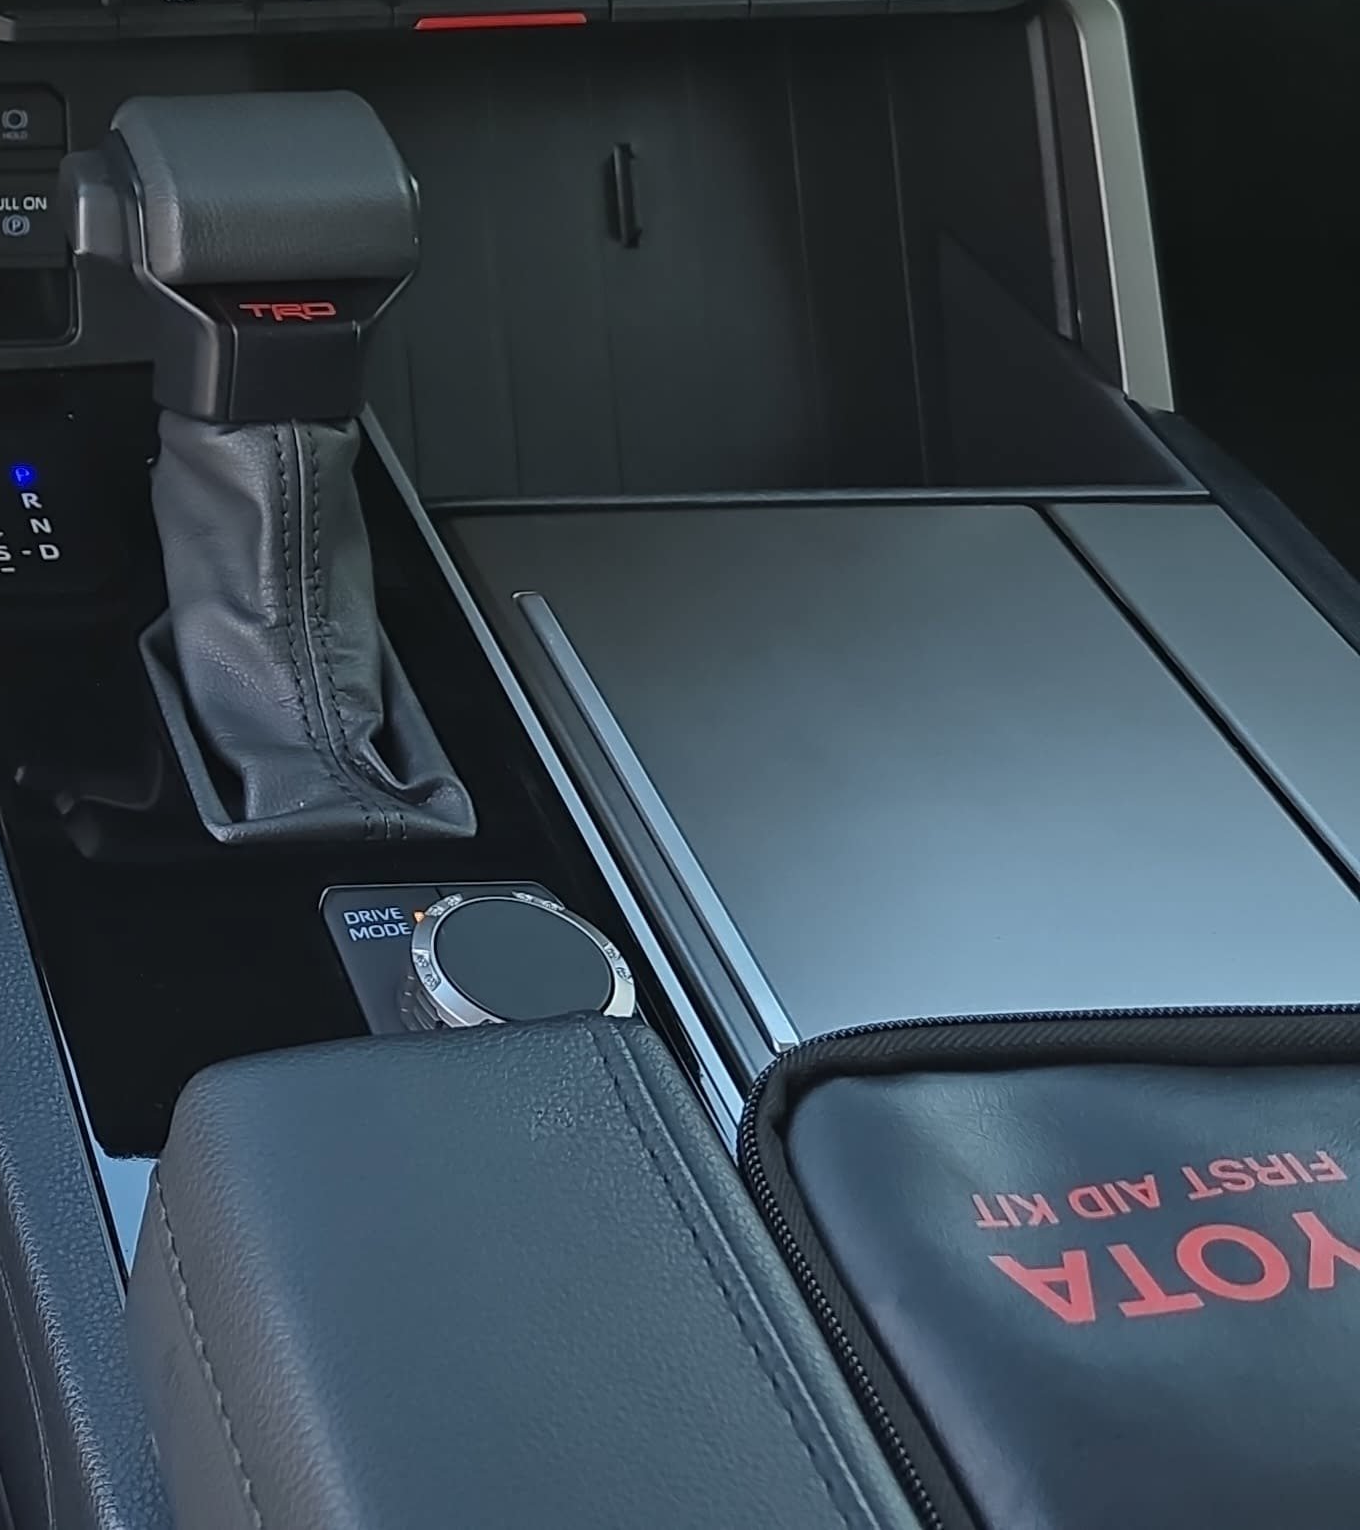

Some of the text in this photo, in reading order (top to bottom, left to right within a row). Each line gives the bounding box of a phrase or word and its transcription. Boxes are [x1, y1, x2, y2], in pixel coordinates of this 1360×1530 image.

[23, 195, 48, 211] ON
[239, 302, 337, 321] TRD
[15, 467, 31, 483] P
[21, 492, 42, 509] R
[29, 517, 53, 534] N
[38, 543, 61, 560] D
[343, 906, 404, 925] DRIVE
[349, 922, 412, 942] MODE
[970, 1151, 1348, 1228] FIRST AID KIT
